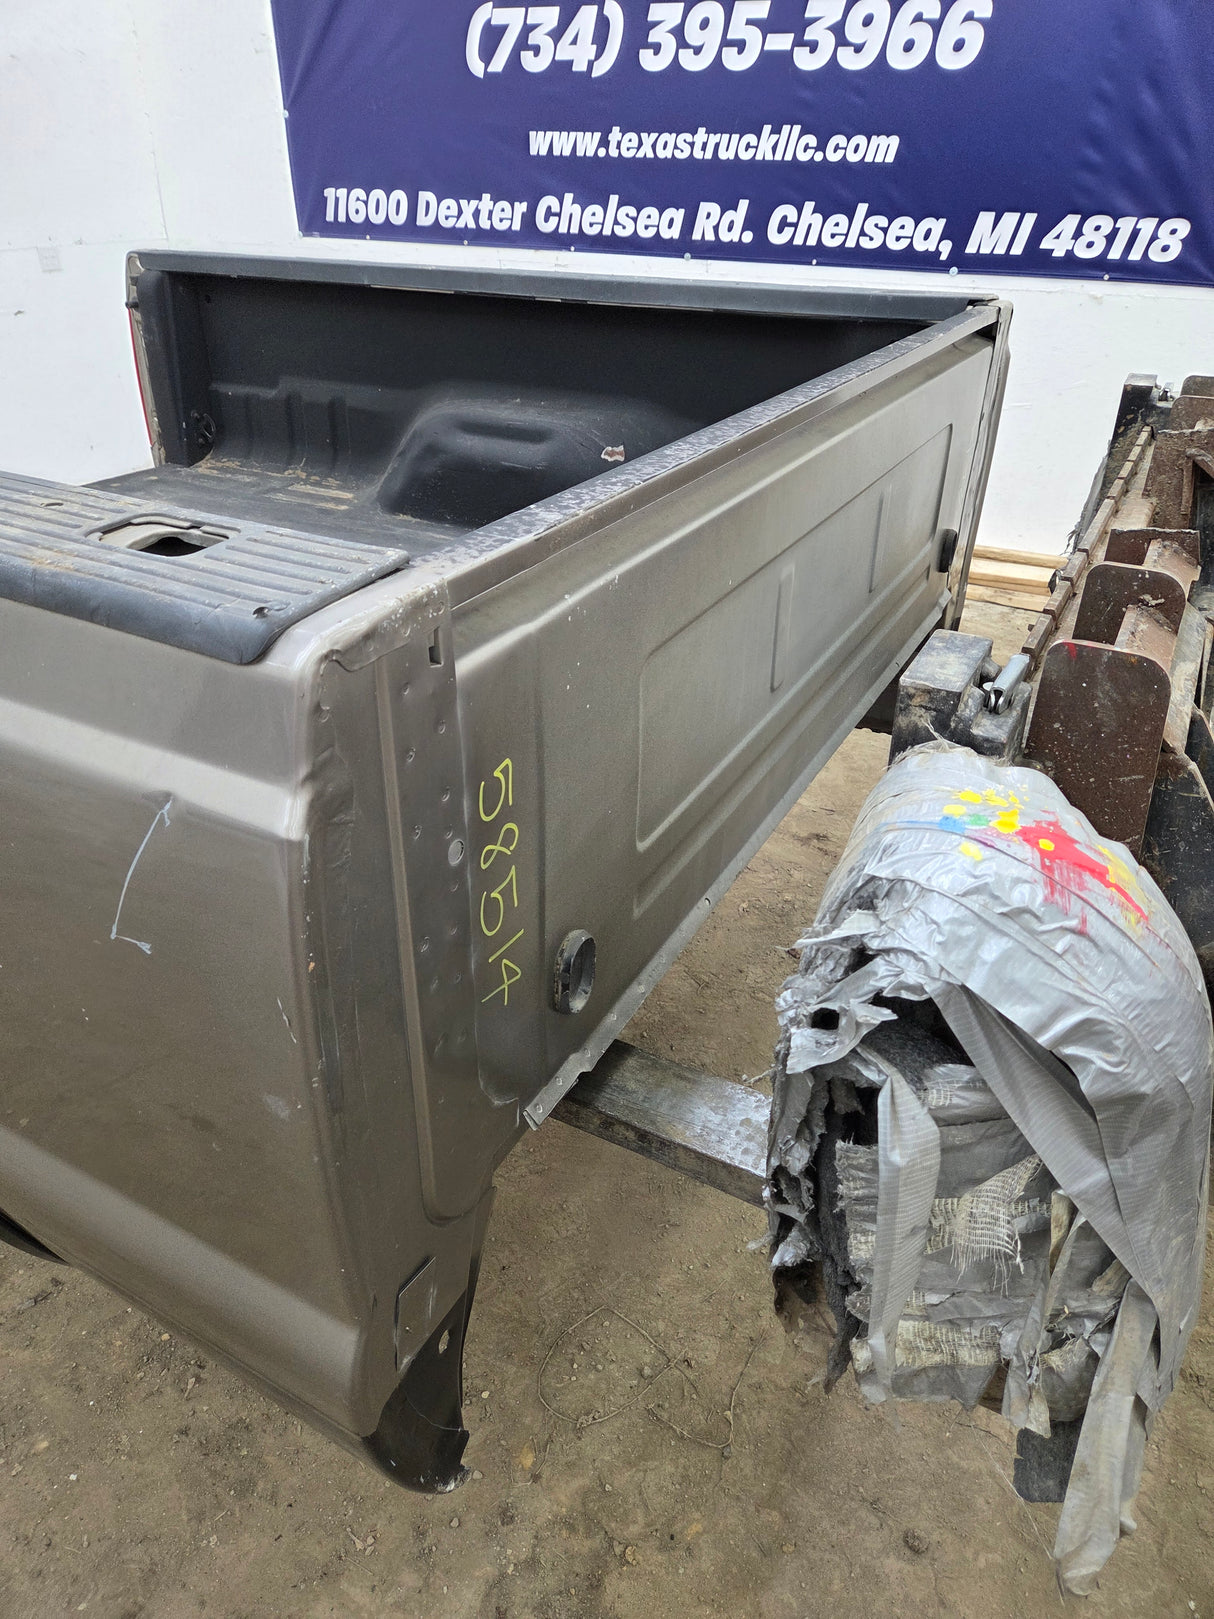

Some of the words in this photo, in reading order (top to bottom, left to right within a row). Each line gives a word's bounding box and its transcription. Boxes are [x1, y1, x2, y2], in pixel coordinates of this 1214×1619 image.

[465, 0, 625, 79] (734)
[638, 0, 994, 73] 395-3966
[528, 124, 901, 164] www.texastruckllc.com
[323, 186, 409, 226] 11600
[416, 190, 527, 232] Dexter
[535, 192, 686, 240] Chelsea
[691, 198, 754, 244] Rd.
[767, 200, 953, 261] Chelsea,
[964, 211, 1039, 256] MI
[1038, 213, 1192, 263] 48118
